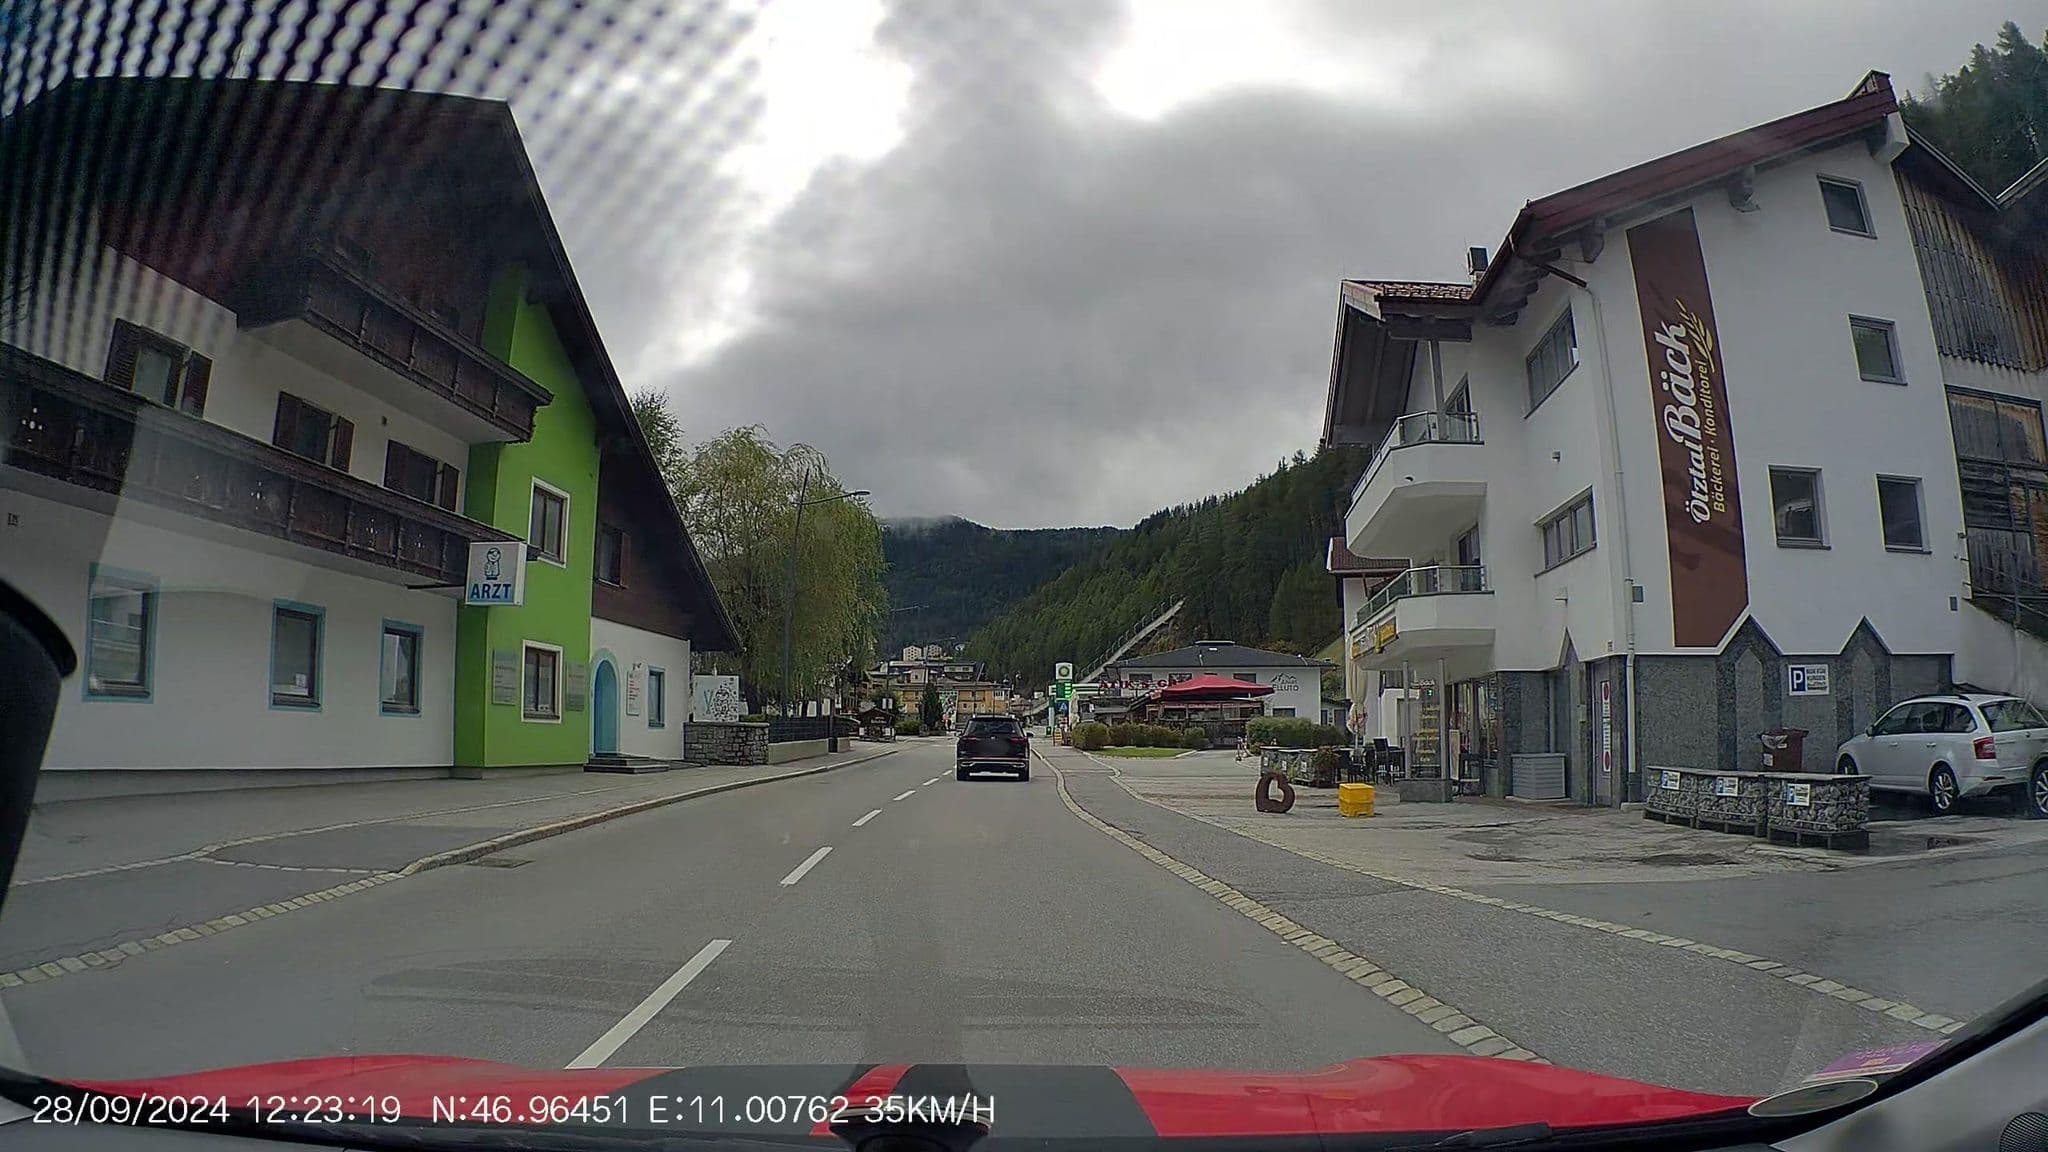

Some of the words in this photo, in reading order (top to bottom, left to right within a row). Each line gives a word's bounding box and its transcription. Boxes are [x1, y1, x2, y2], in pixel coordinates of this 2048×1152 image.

[1698, 360, 1718, 436] Konditorei
[1709, 448, 1725, 512] Bäckerei
[470, 583, 511, 599] ARZT
[1793, 670, 1803, 689] P
